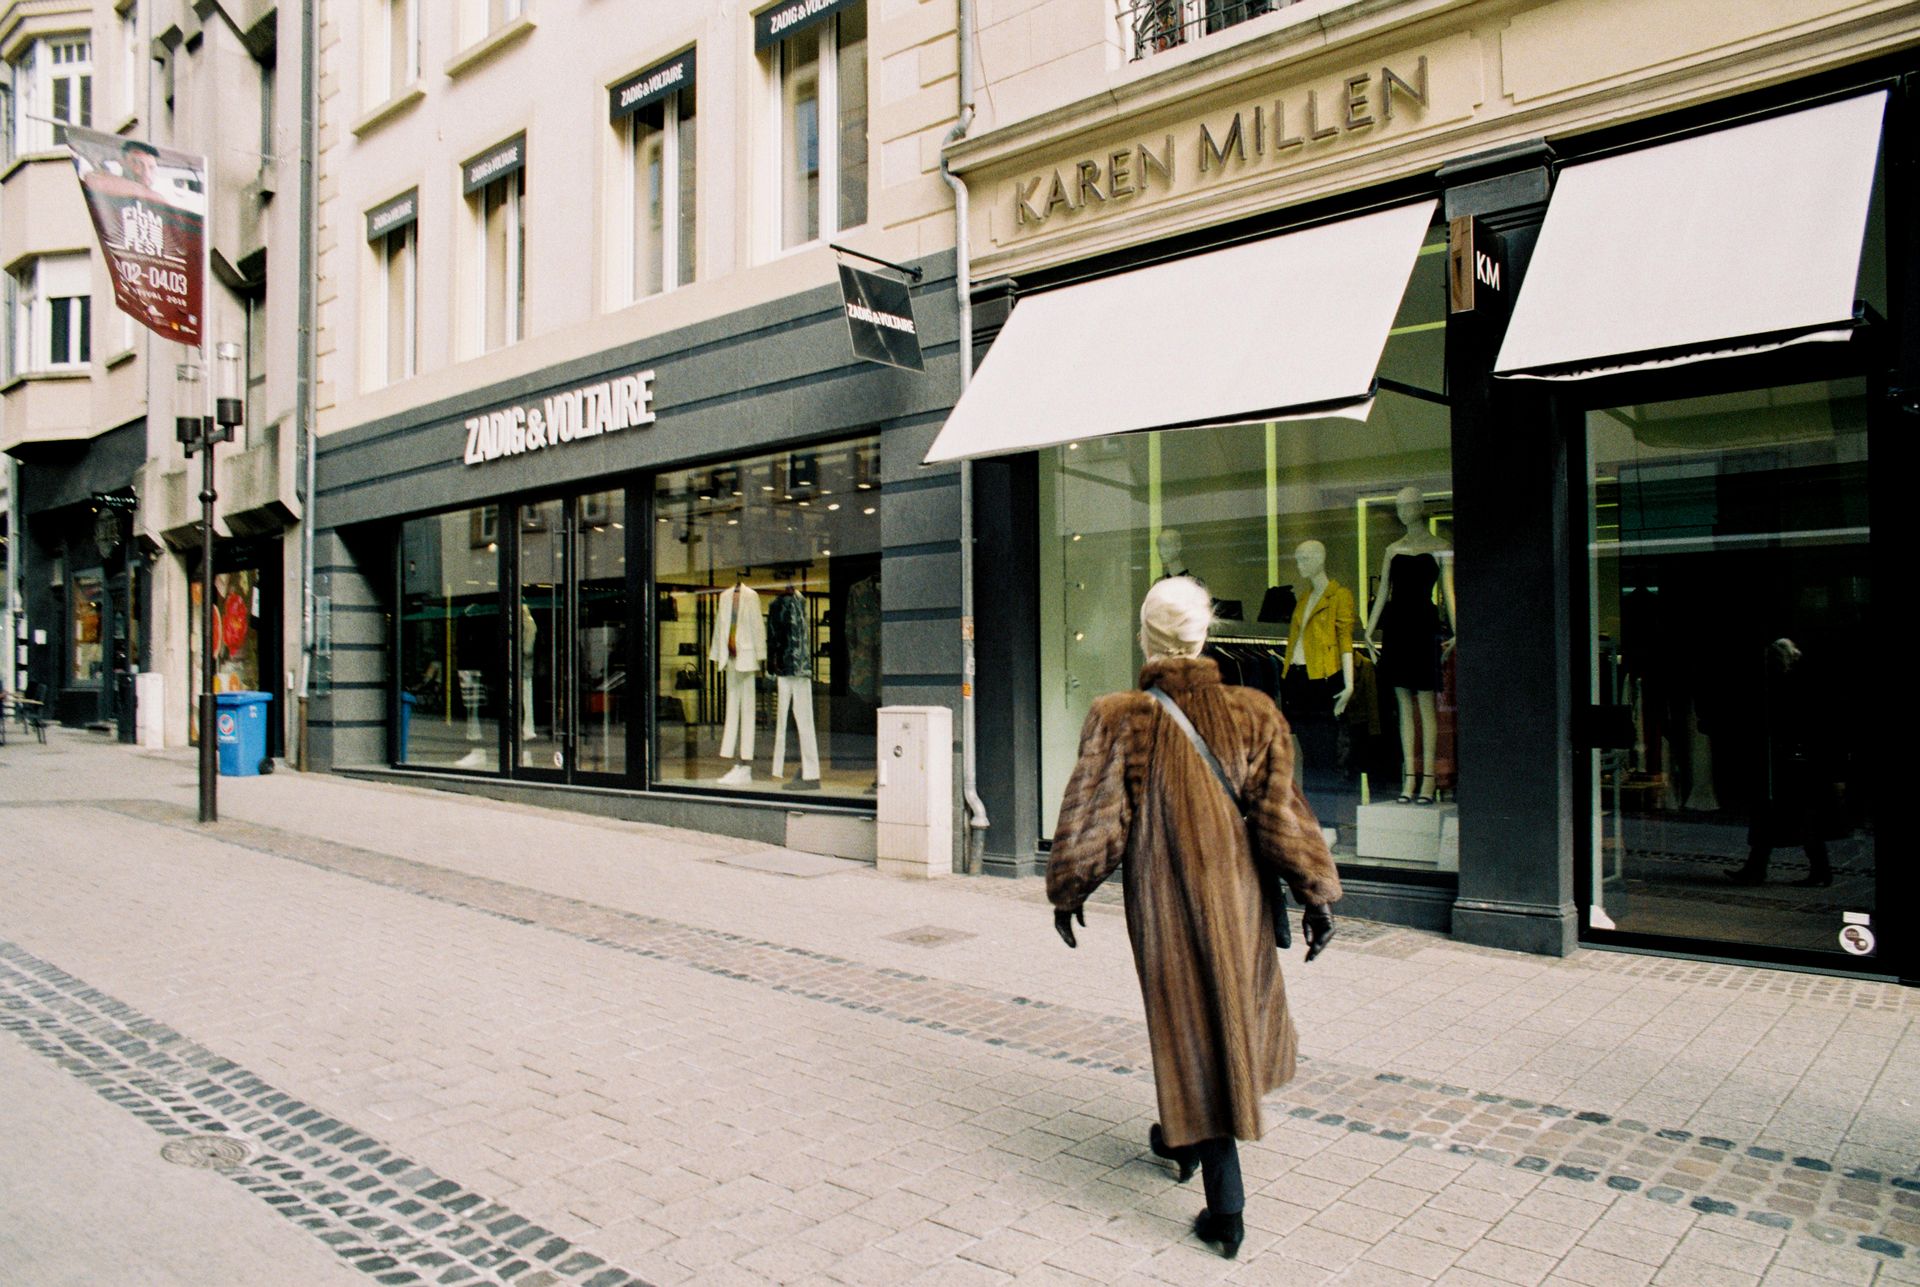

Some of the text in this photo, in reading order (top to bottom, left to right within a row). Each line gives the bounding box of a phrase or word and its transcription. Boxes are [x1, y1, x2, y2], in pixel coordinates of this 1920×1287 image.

[1015, 54, 1429, 225] KAREN MILLEN
[124, 238, 163, 257] FEST
[1476, 250, 1501, 291] KM
